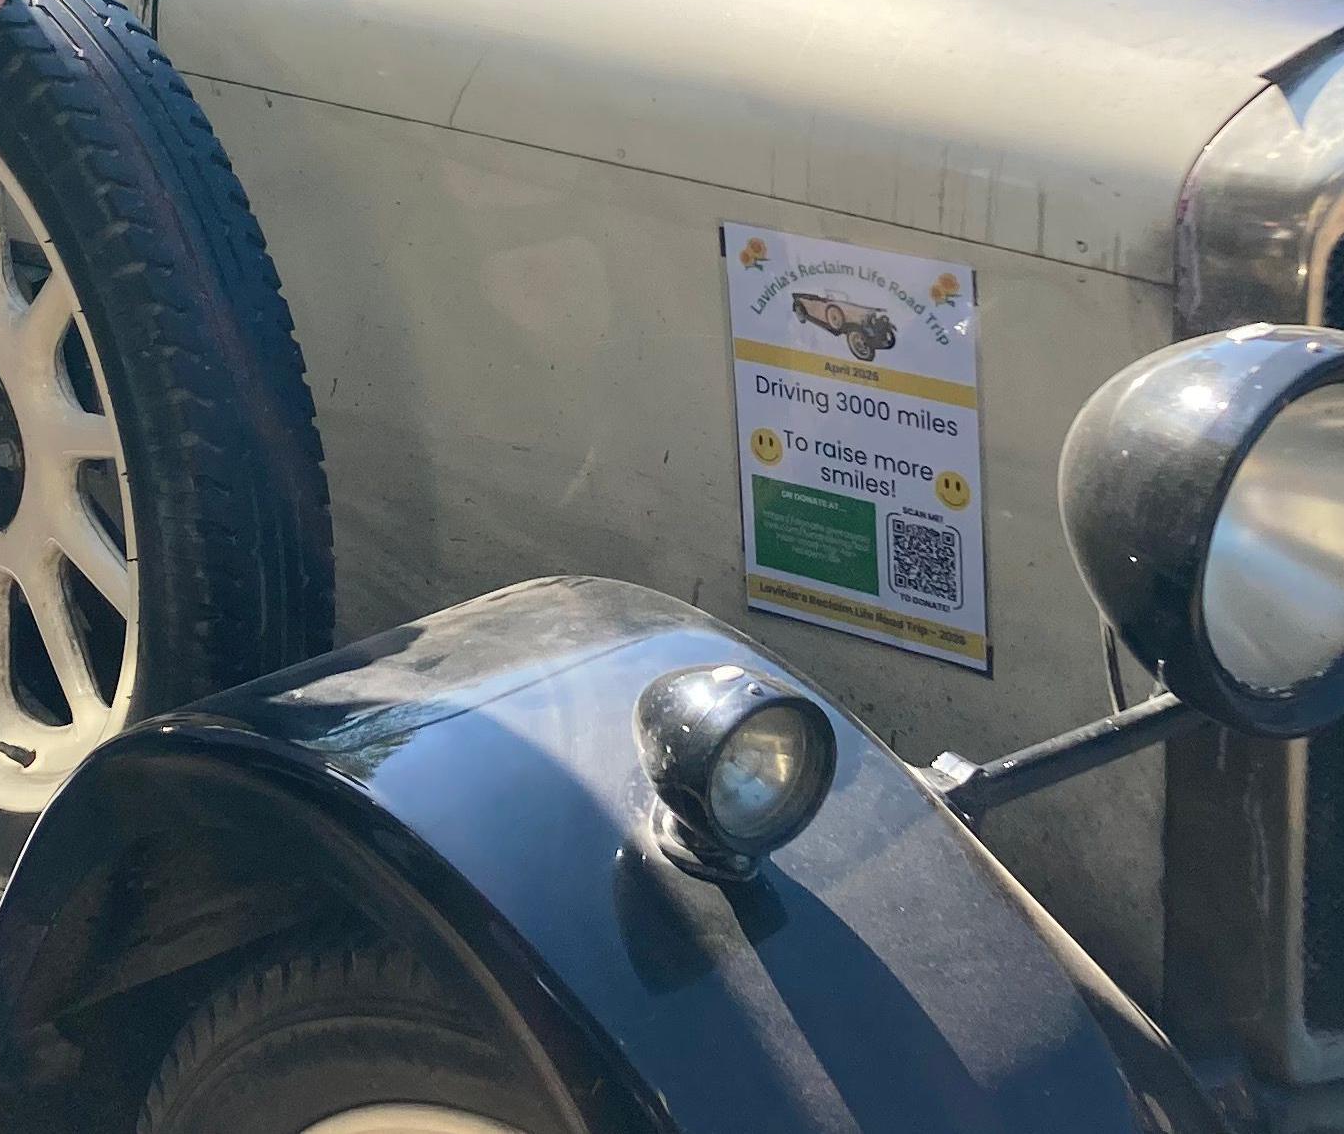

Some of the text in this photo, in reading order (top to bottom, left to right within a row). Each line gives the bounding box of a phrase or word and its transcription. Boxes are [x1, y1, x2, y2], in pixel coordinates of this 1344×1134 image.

[751, 259, 952, 347] Lavinia's Reclaim Life Road Trip
[824, 361, 850, 377] April
[755, 374, 959, 437] Driving 3000 miles
[783, 429, 934, 482] To raise more
[820, 465, 897, 498] smiles!
[759, 581, 808, 603] Lavinia's
